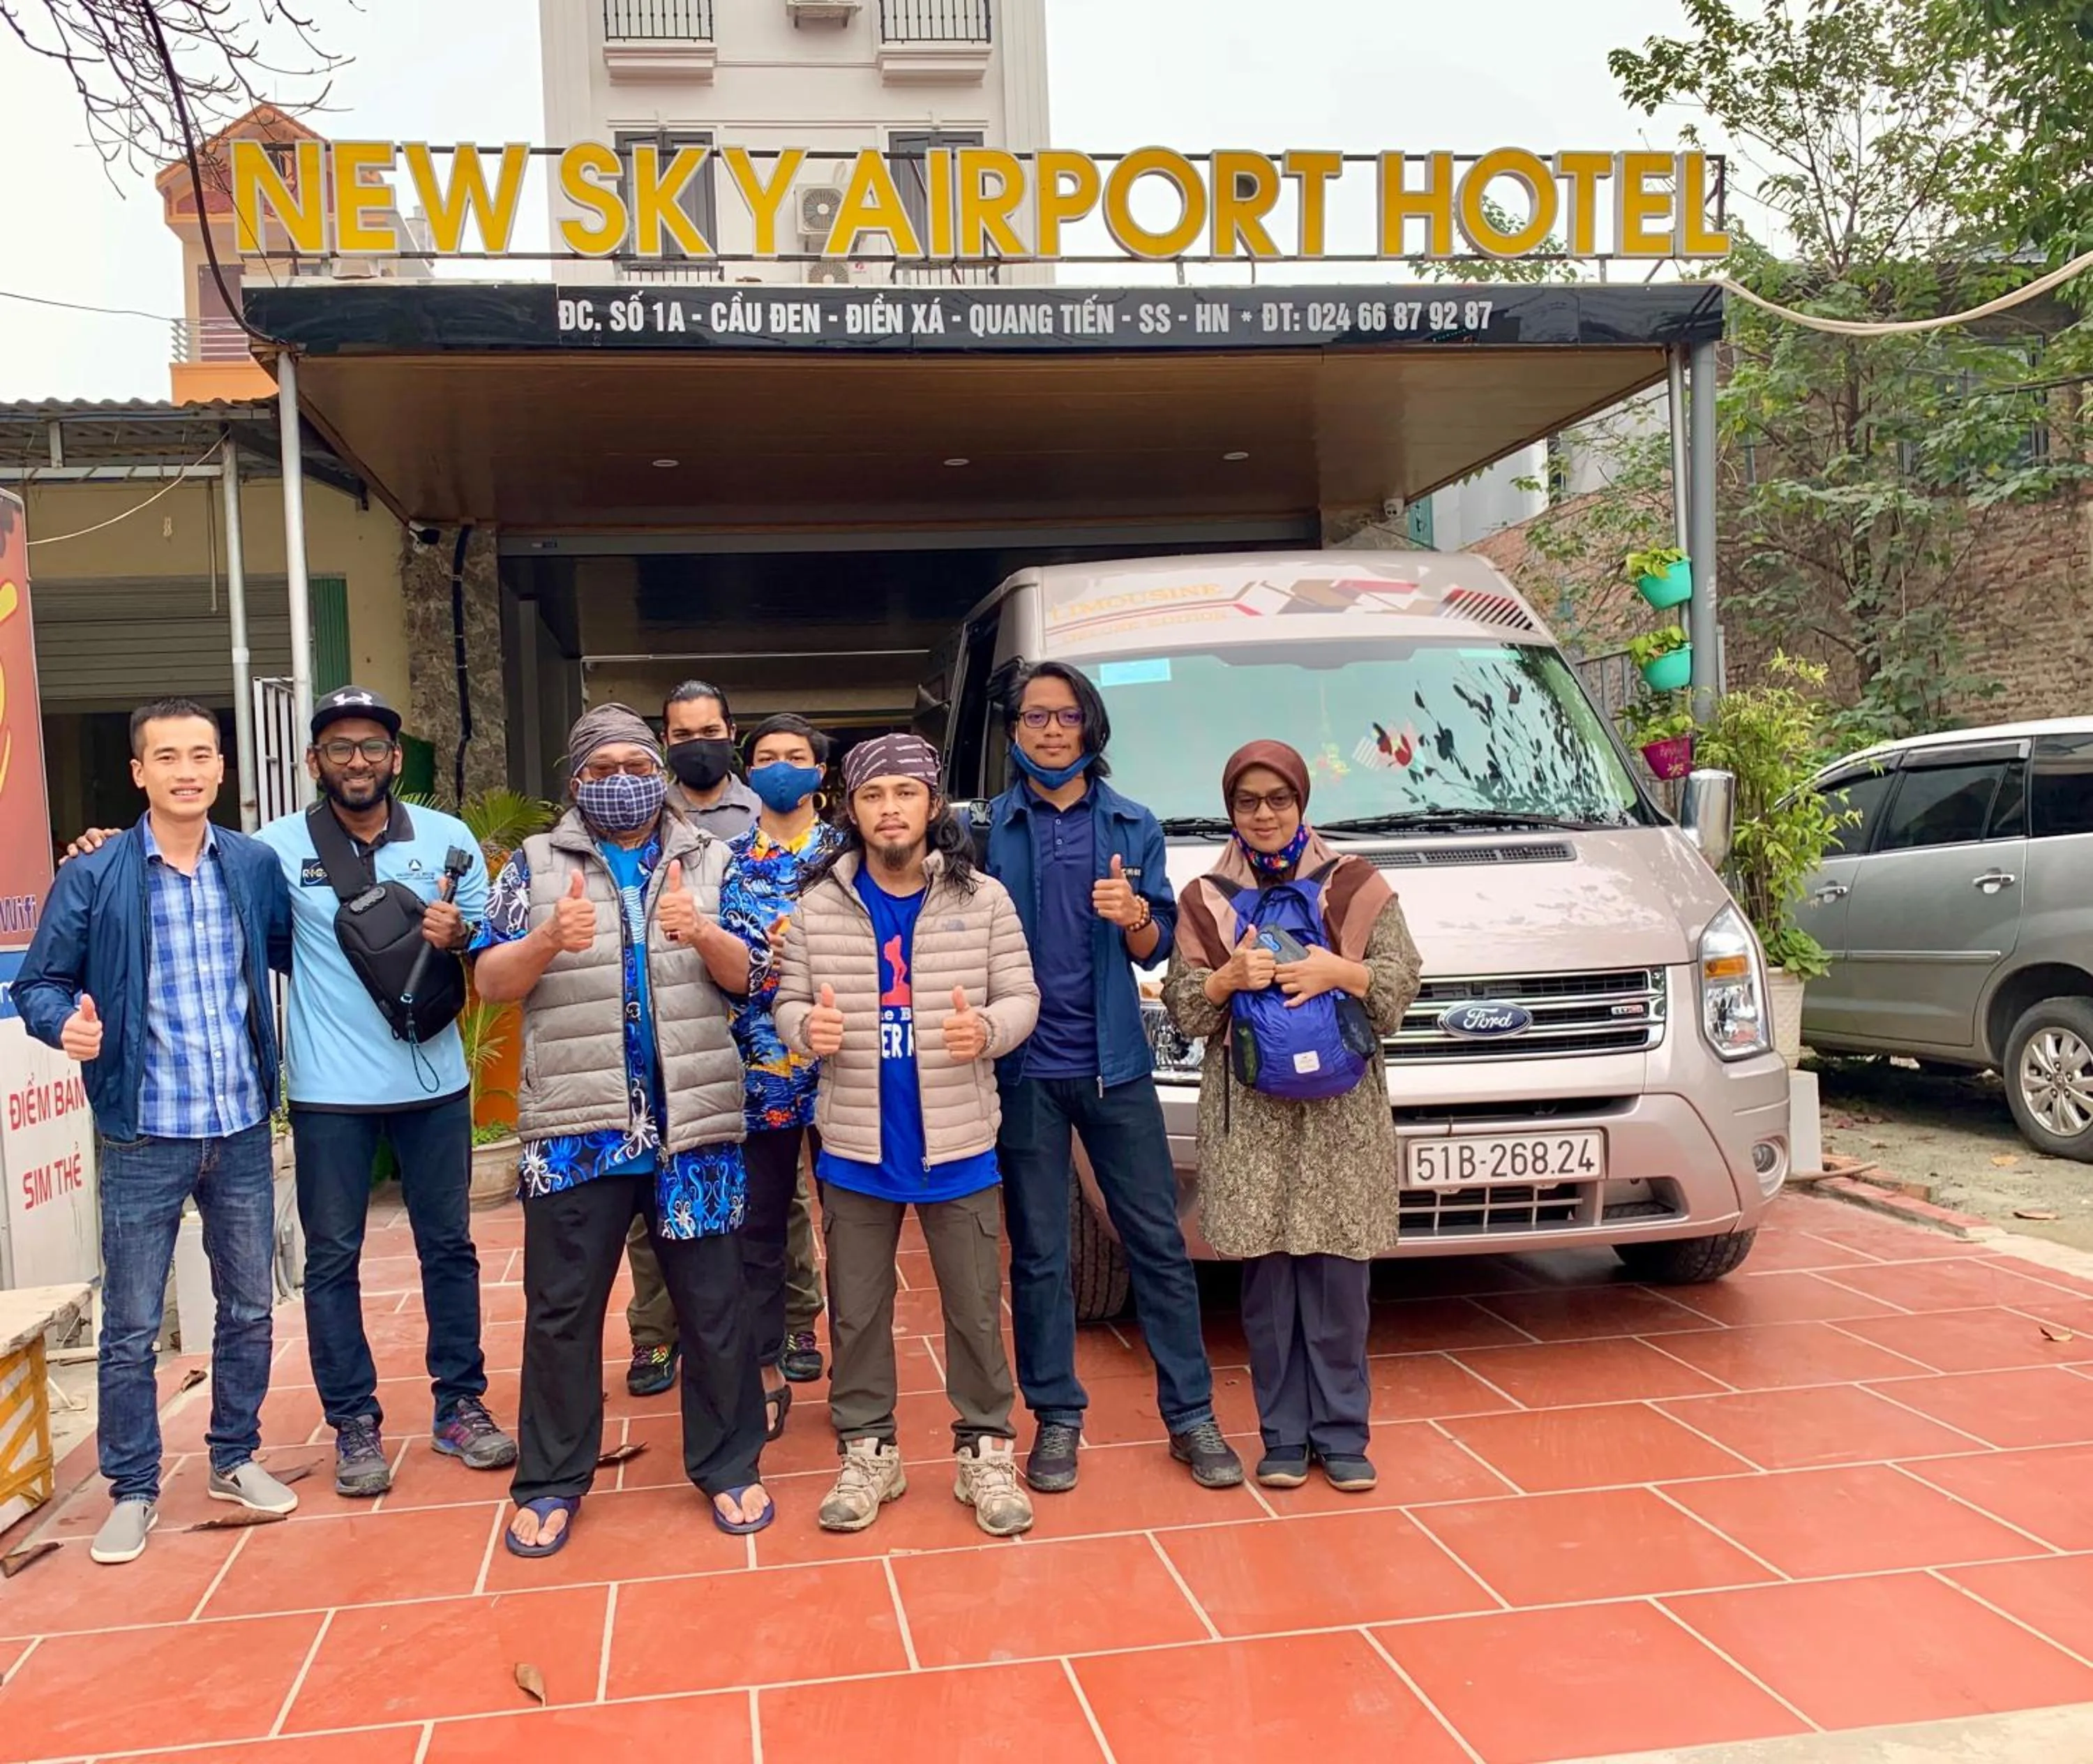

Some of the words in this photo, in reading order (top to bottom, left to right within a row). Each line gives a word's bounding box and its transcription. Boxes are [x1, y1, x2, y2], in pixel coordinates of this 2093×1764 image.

[232, 140, 530, 257] NEW
[558, 142, 809, 258] SKY
[822, 145, 1344, 260] AIRPORT
[1376, 145, 1733, 260] HOTEL
[558, 299, 601, 331] ĐC.
[610, 290, 645, 331] SỐ
[652, 301, 686, 332] 1A
[711, 291, 763, 333] CẦU
[770, 303, 821, 334] ĐEN
[846, 293, 903, 334] ĐIỀN
[910, 297, 945, 334] XÁ
[969, 304, 1053, 338] QUANG
[1060, 293, 1115, 334] TIẾN
[1139, 303, 1171, 334] SS
[1195, 303, 1230, 334] HN
[1261, 302, 1300, 332] ĐT:
[1307, 302, 1351, 332] 024
[1358, 301, 1387, 331] 66
[1393, 301, 1423, 331] 87
[1430, 301, 1459, 331] 92
[1464, 300, 1494, 331] 87
[1463, 1007, 1513, 1030] Ford
[9, 1072, 52, 1130] ĐIỂM
[54, 1069, 85, 1117] BÁN
[23, 1165, 52, 1210] SIM
[54, 1142, 82, 1195] THẺ
[1416, 1138, 1595, 1181] 51B-268.24
